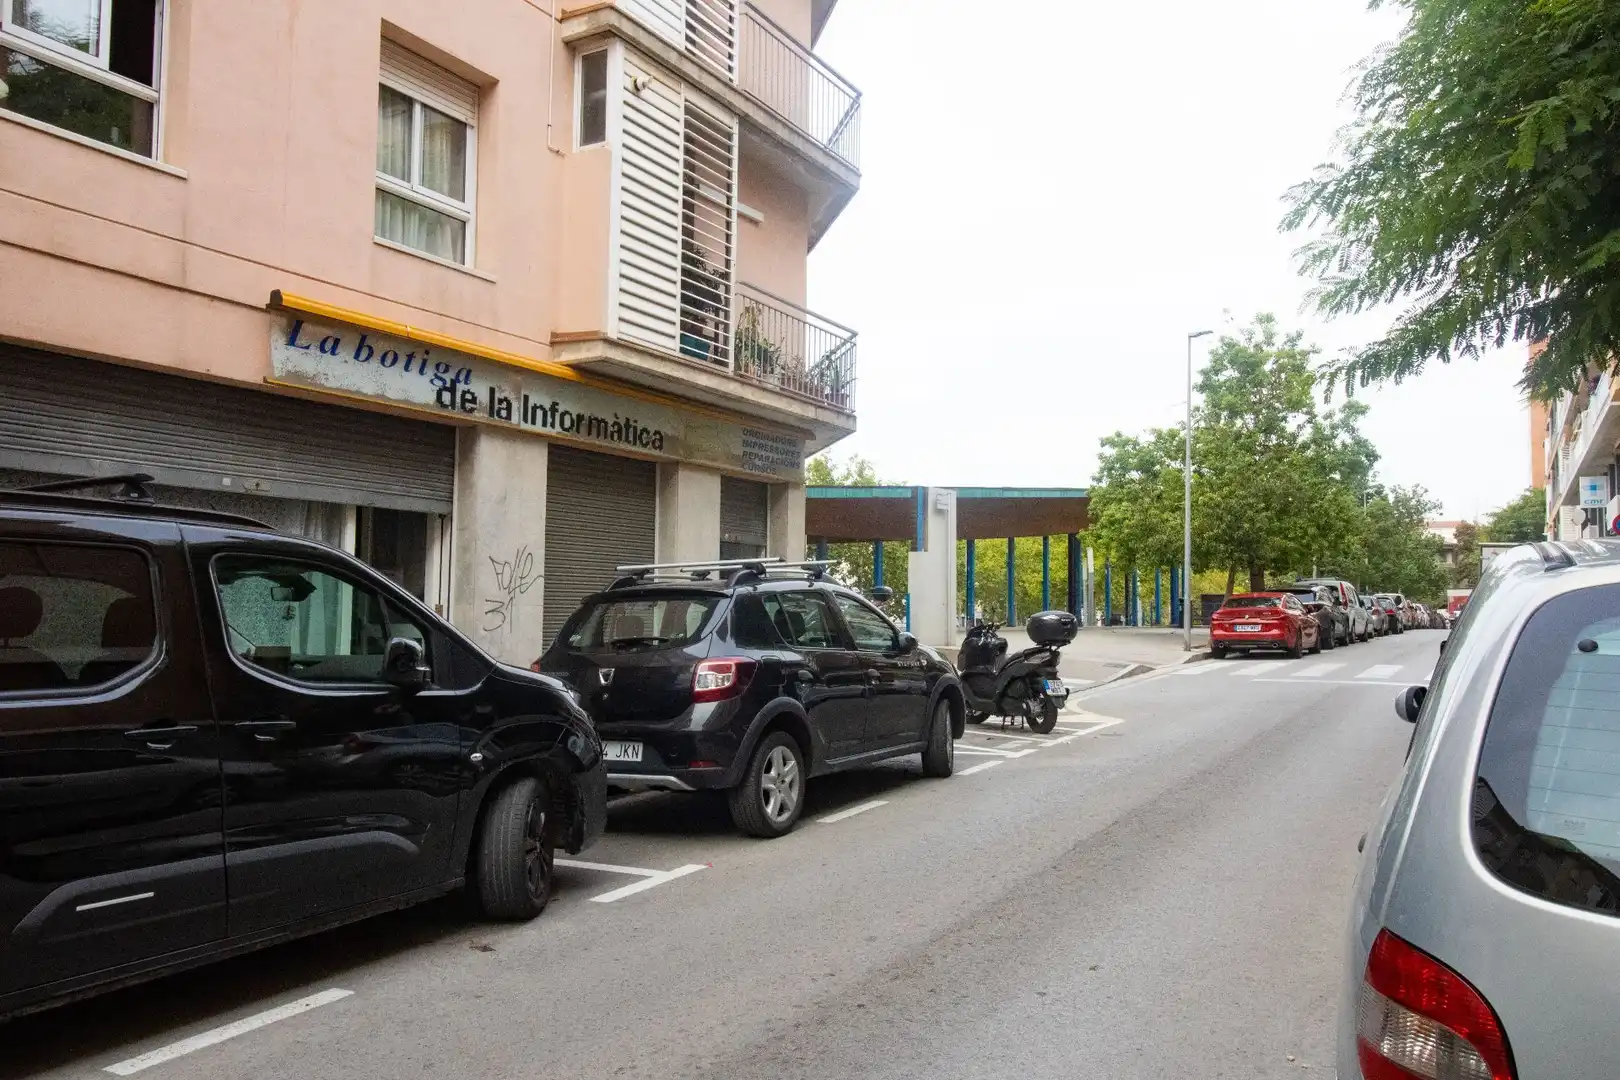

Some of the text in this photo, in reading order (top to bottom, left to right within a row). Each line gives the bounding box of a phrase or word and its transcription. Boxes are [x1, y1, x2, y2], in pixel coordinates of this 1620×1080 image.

[284, 319, 473, 387] La botiga
[435, 378, 664, 451] de la Informàtica
[615, 743, 640, 759] JKN
